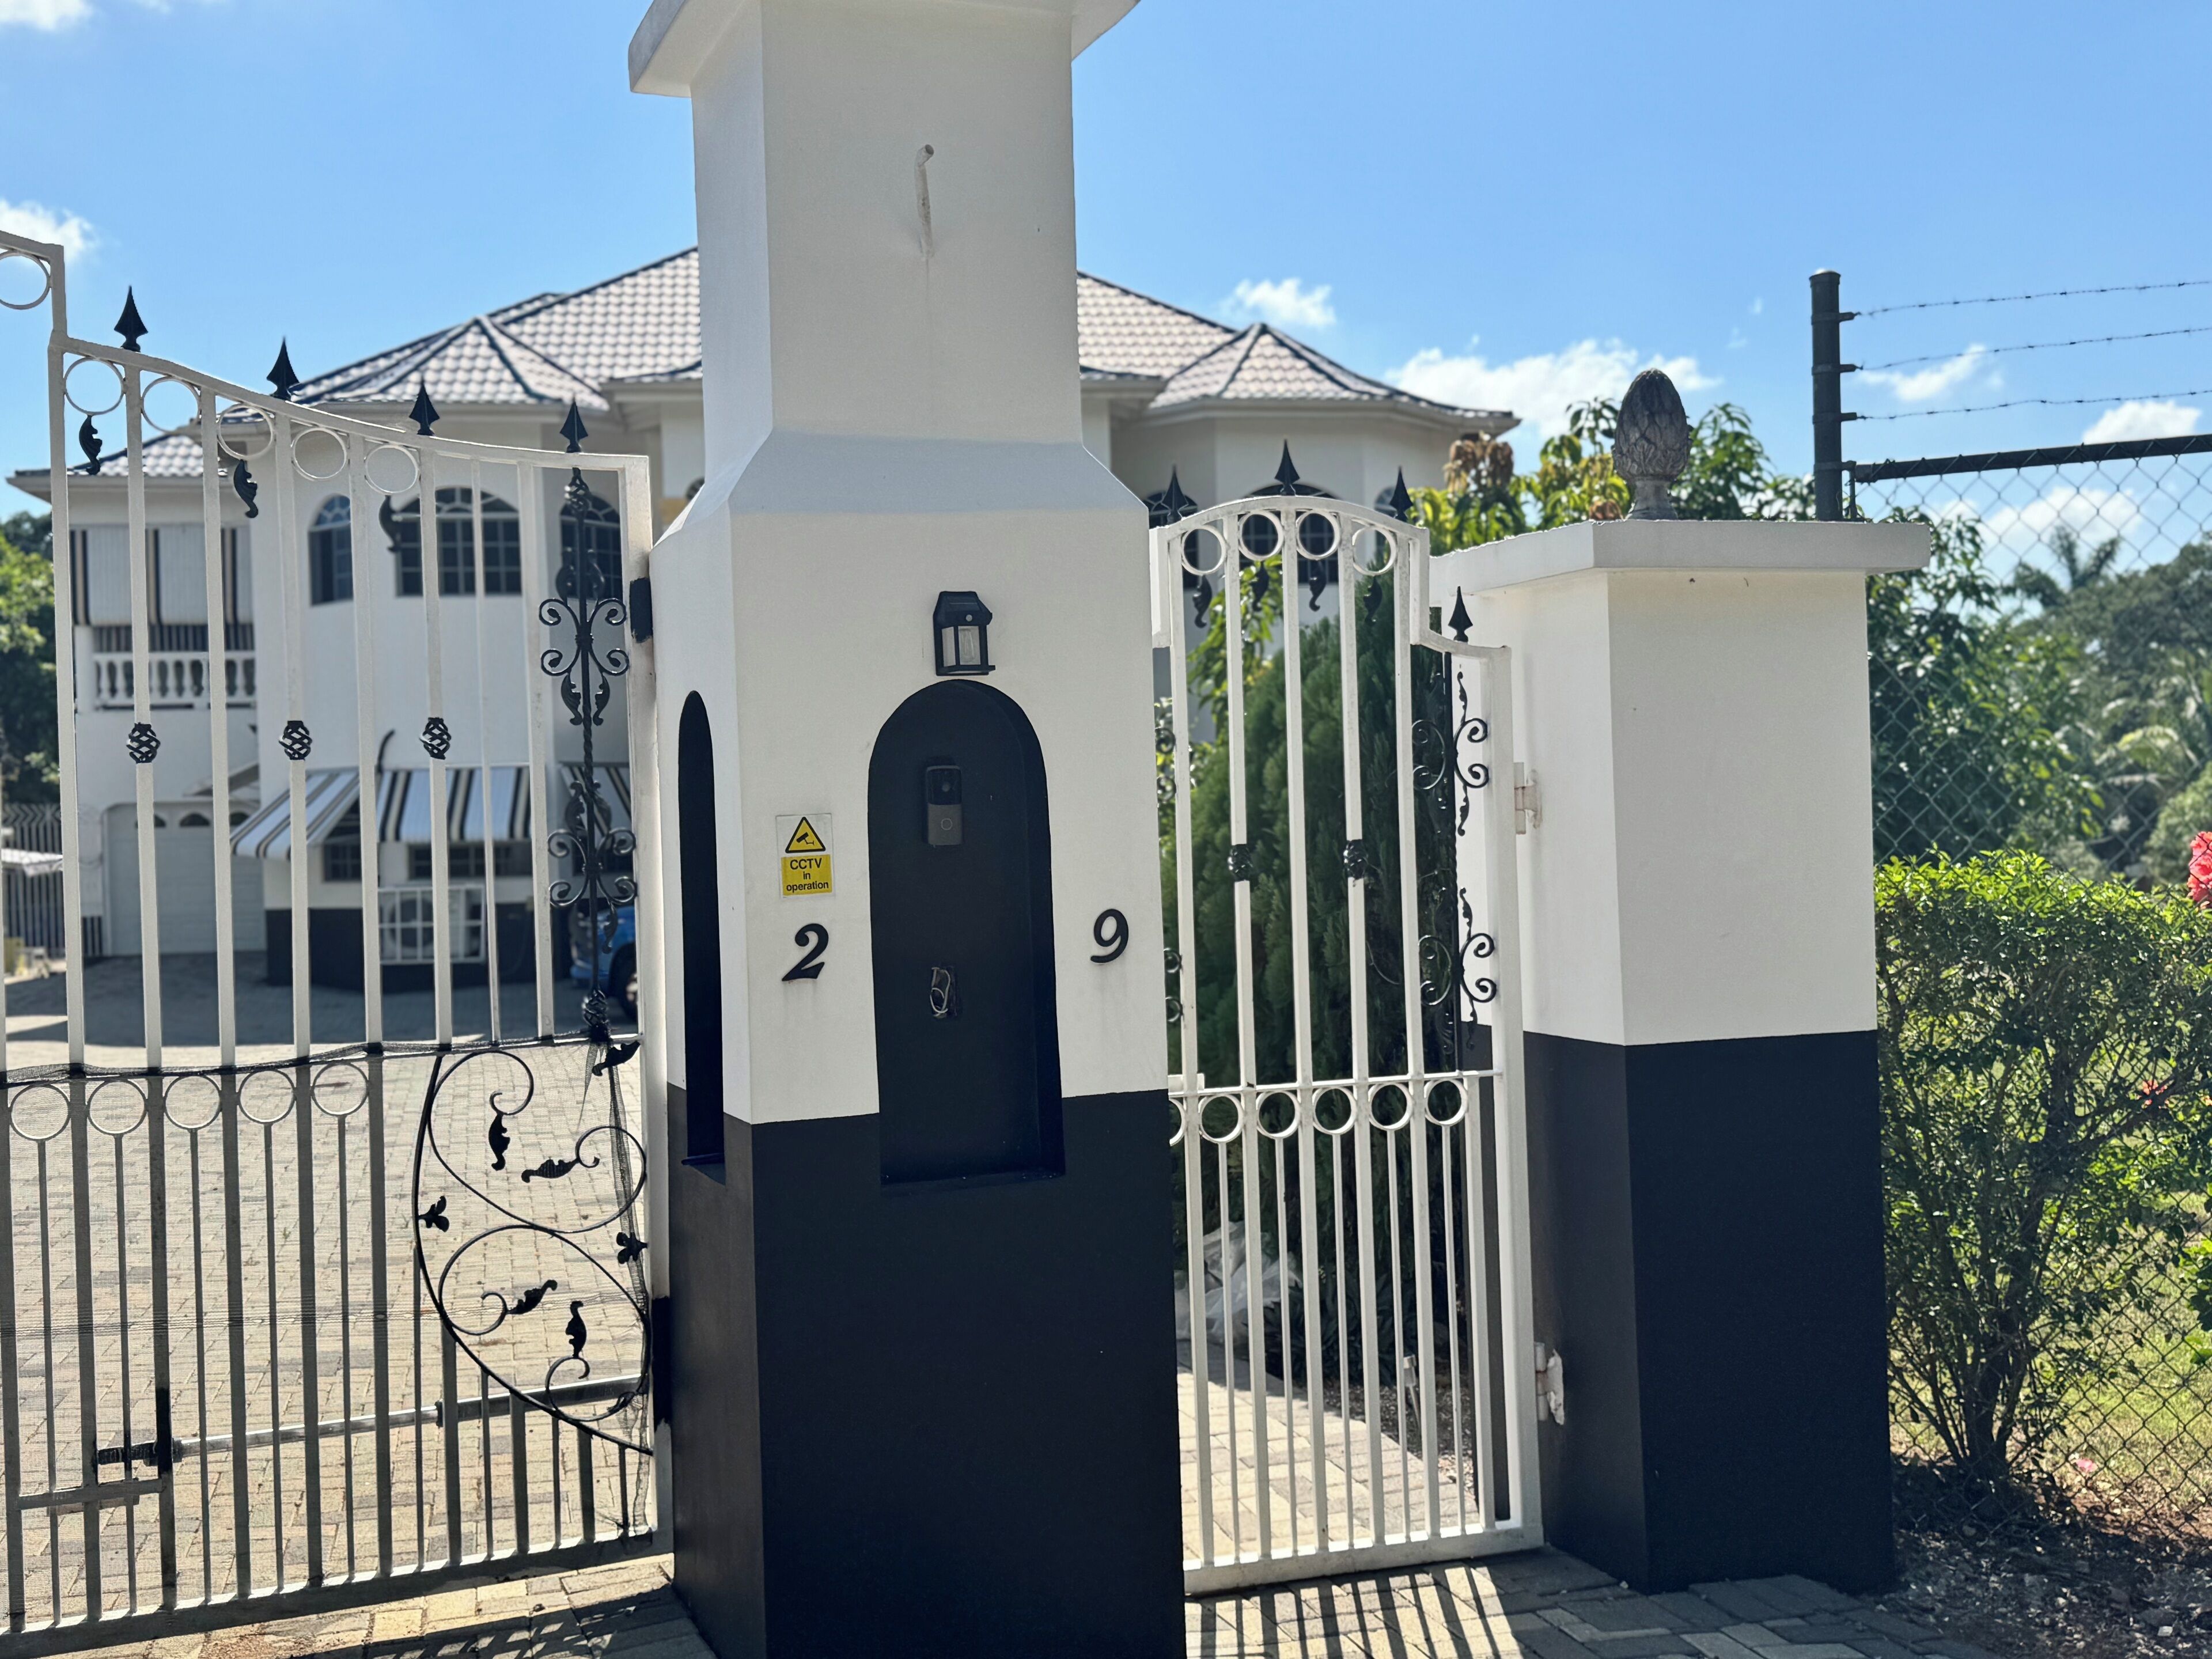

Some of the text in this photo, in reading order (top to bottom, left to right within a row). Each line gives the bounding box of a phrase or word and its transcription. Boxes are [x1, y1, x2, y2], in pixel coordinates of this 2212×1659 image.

[790, 858, 822, 870] CCTV
[803, 871, 811, 880] in
[786, 881, 829, 893] operation
[781, 908, 1129, 982] 2 9
